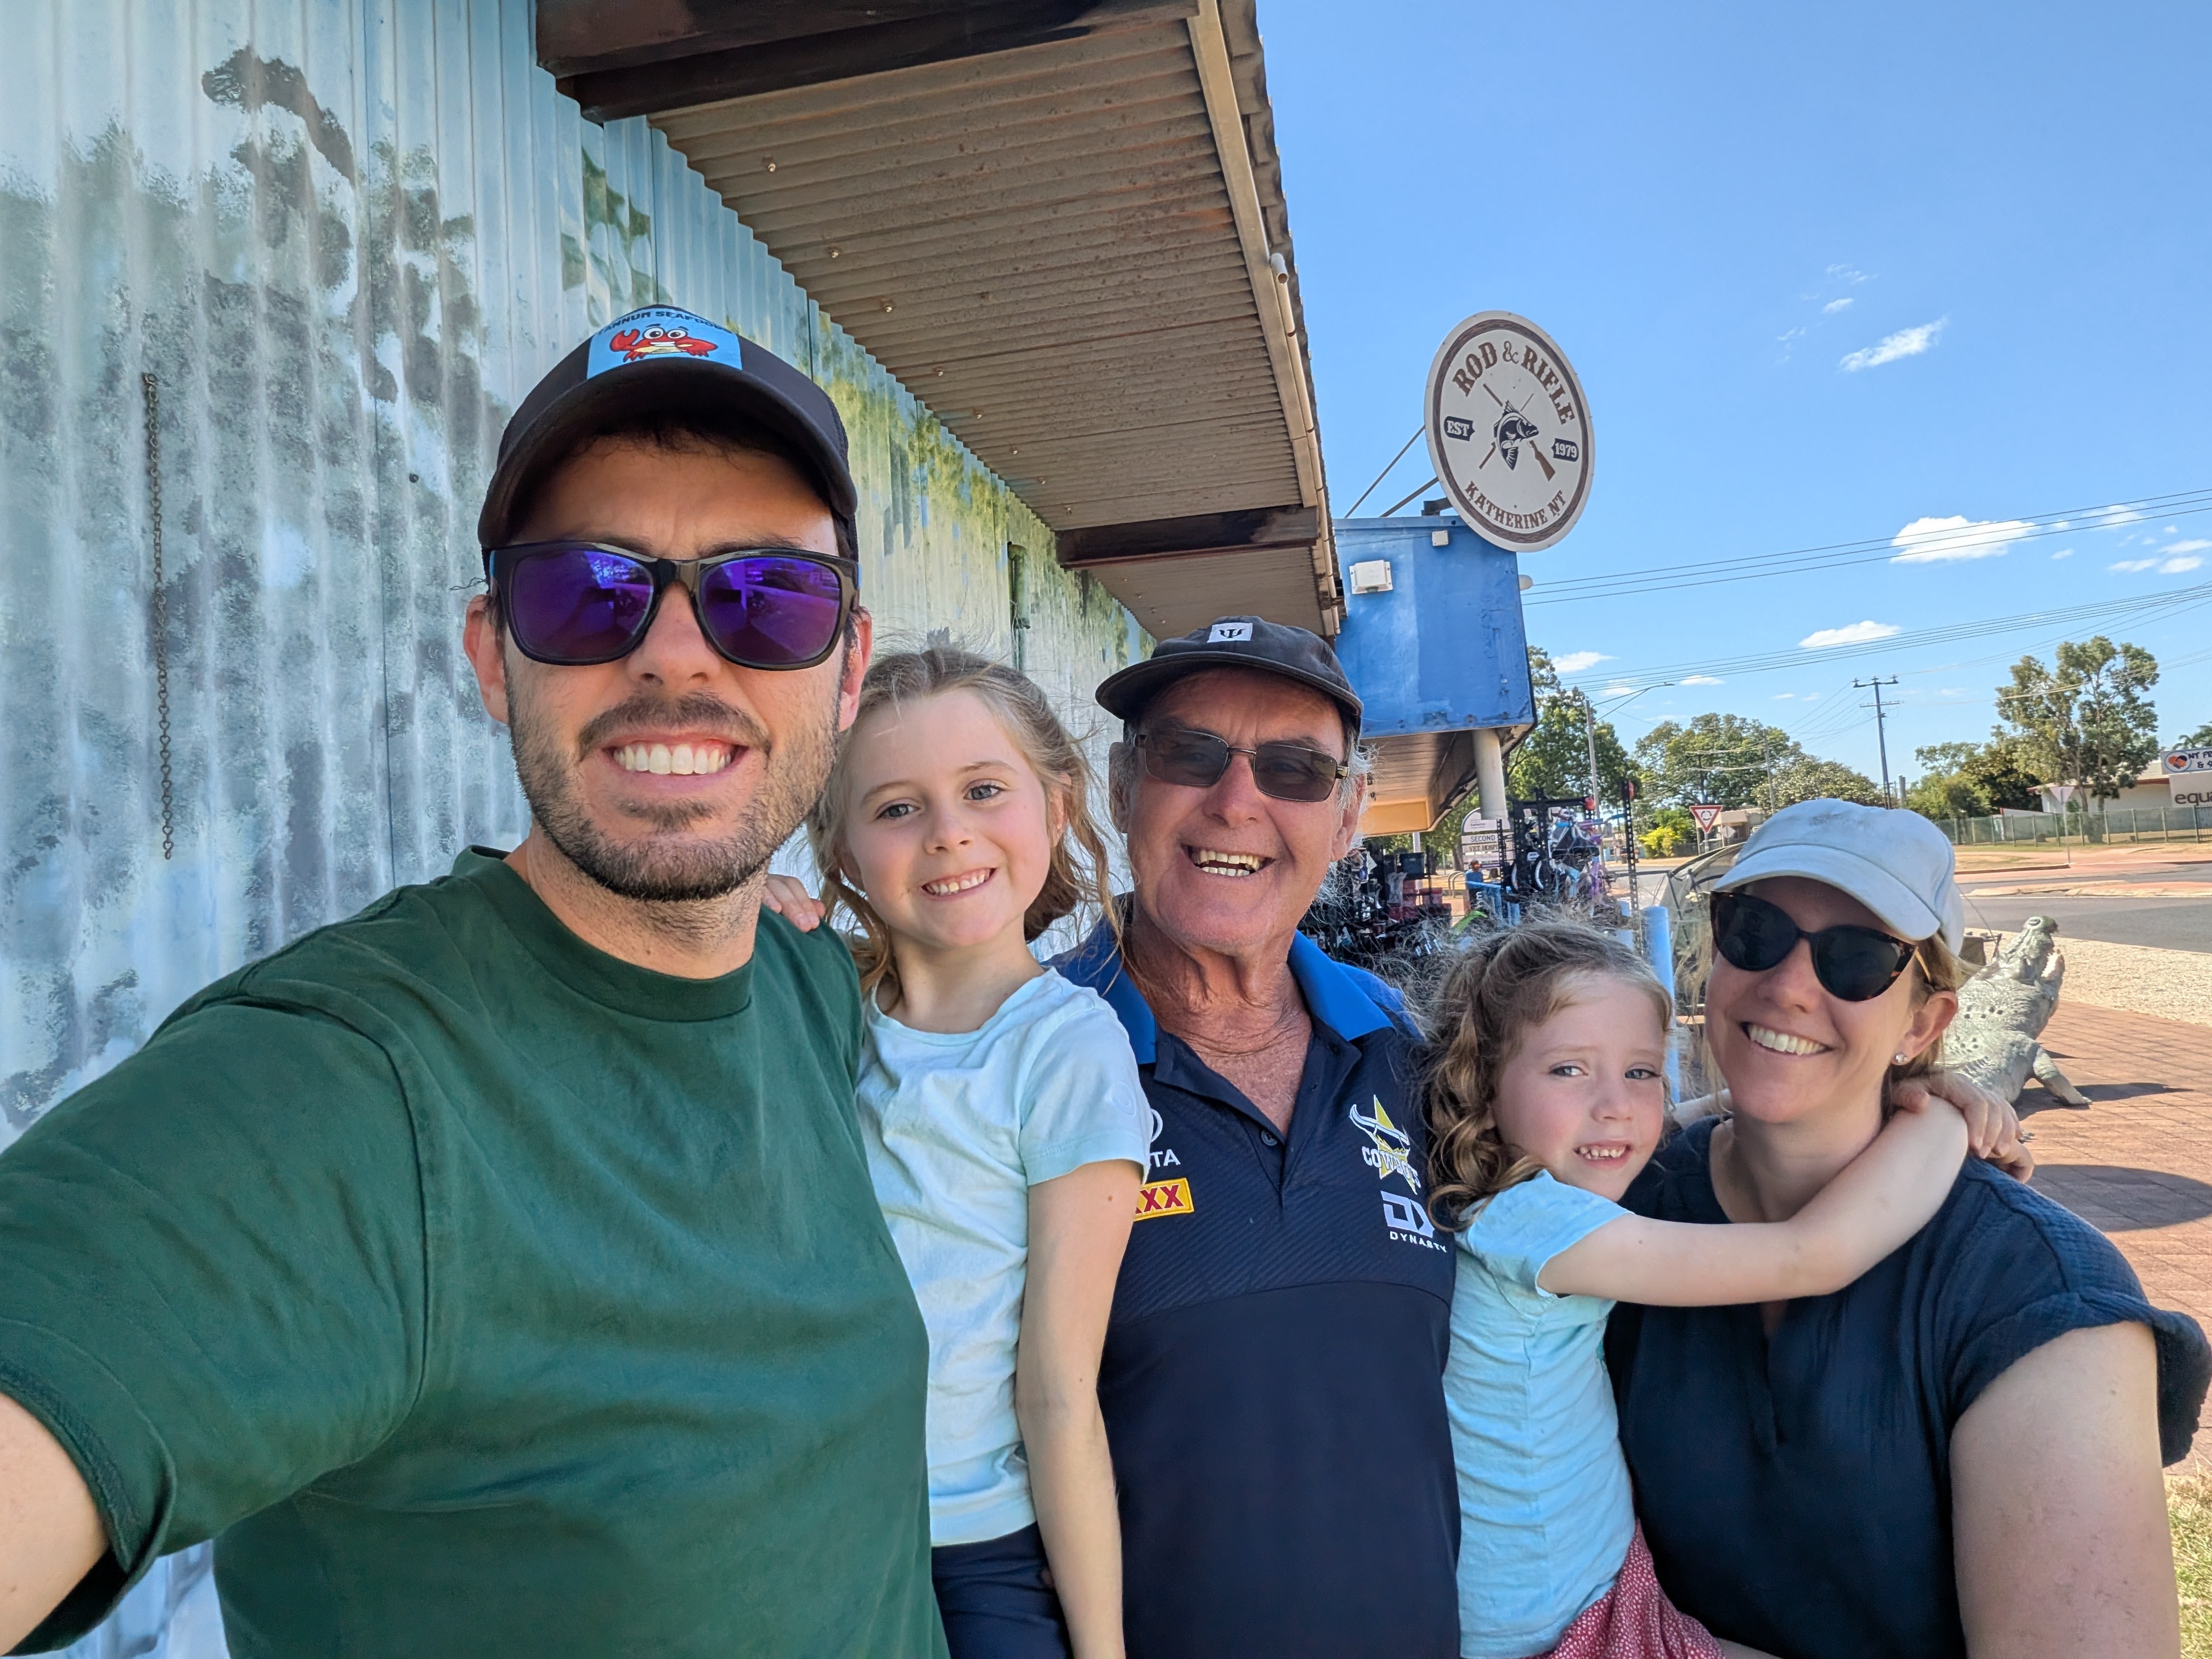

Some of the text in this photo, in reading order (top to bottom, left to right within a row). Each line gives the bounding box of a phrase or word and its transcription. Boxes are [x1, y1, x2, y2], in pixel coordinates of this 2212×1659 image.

[1452, 341, 1576, 425] ROD & RIFLE
[1447, 421, 1470, 436] EST
[1555, 442, 1577, 459] 1979
[1464, 481, 1567, 529] KATHERINE NT
[1471, 834, 1496, 843] SECOND
[1390, 1231, 1447, 1253] DYNASTY
